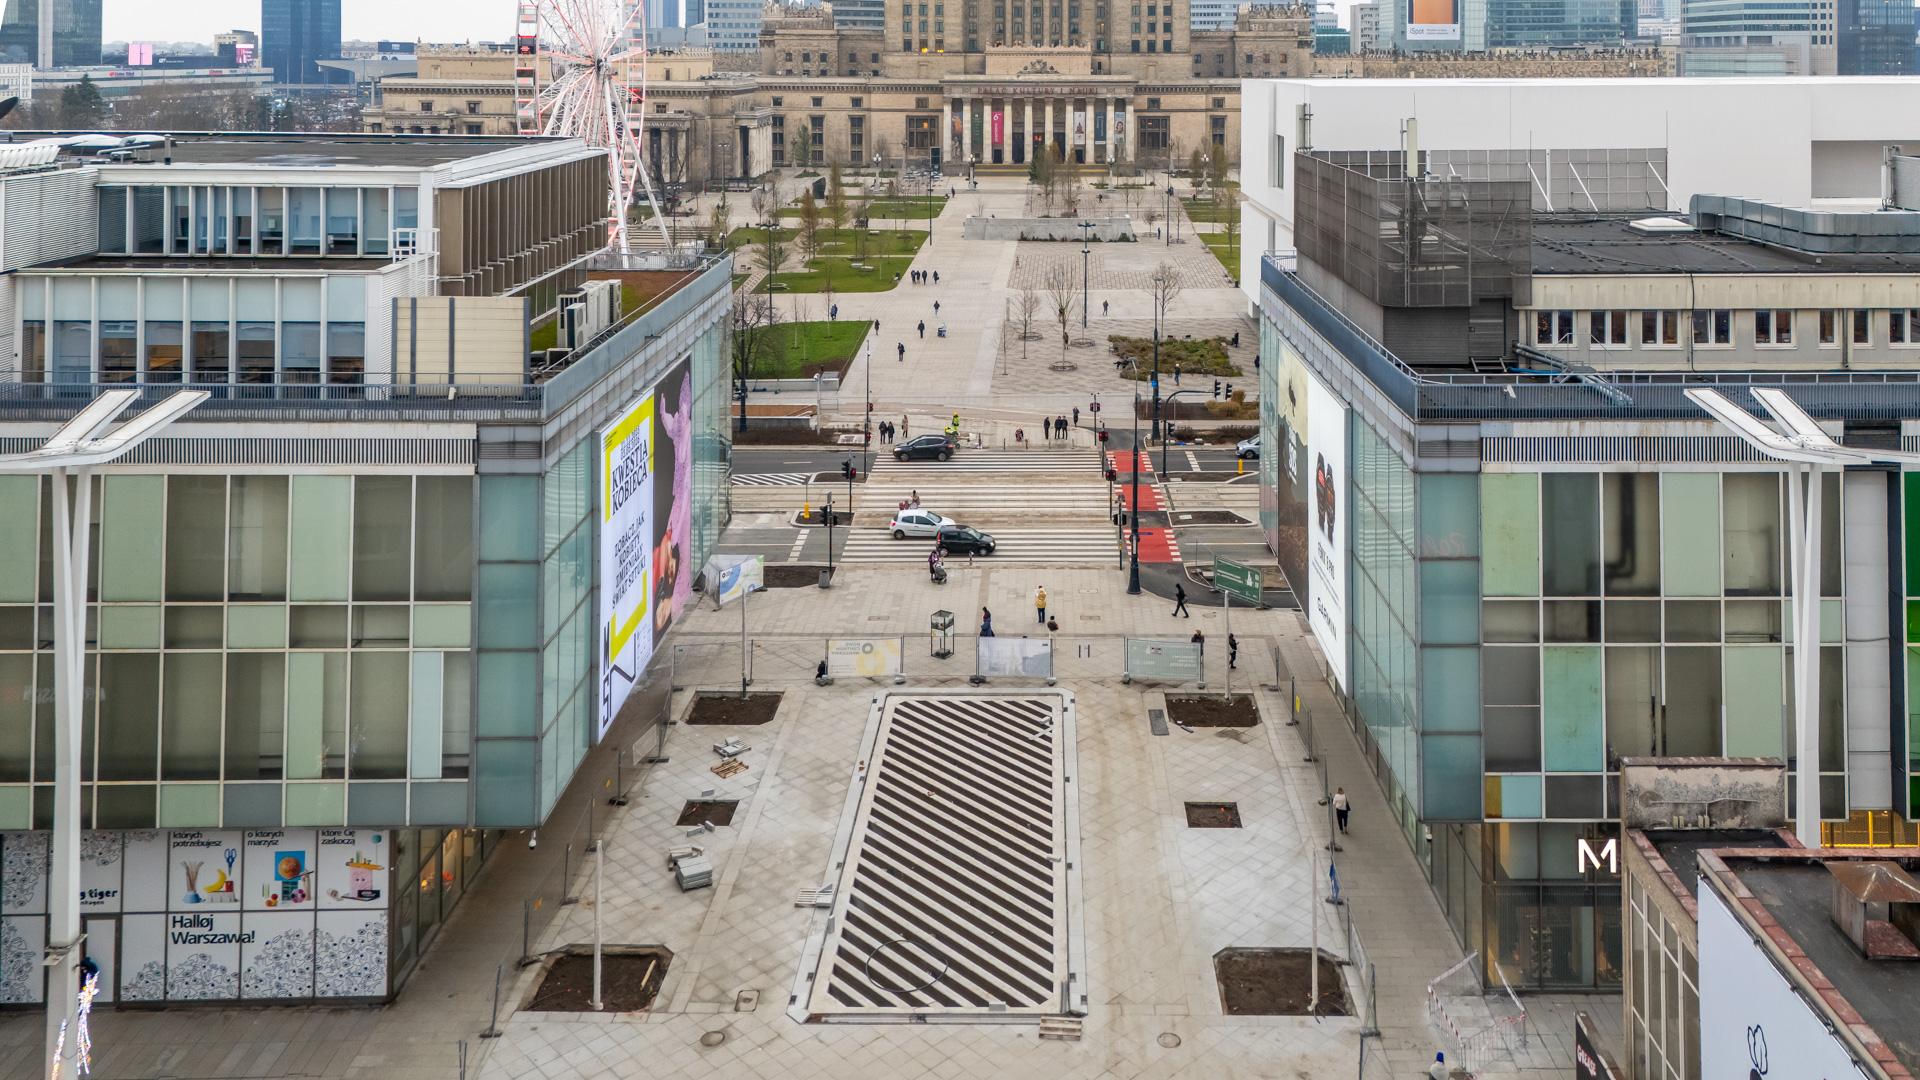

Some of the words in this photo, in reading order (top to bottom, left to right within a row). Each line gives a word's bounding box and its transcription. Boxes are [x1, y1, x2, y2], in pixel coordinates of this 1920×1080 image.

[1012, 87, 1055, 95] KULTURY
[1069, 87, 1099, 95] NAUKI
[612, 440, 648, 492] KWESTIA
[612, 462, 648, 516] KOBIECA
[614, 522, 635, 558] ZOBACZ
[173, 840, 222, 848] potrzebujesz
[248, 839, 279, 847] marzysz
[321, 837, 355, 845] zaskoczą
[88, 888, 118, 900] tiger
[172, 914, 214, 932] Halløj
[172, 930, 255, 945] Warszawa!
